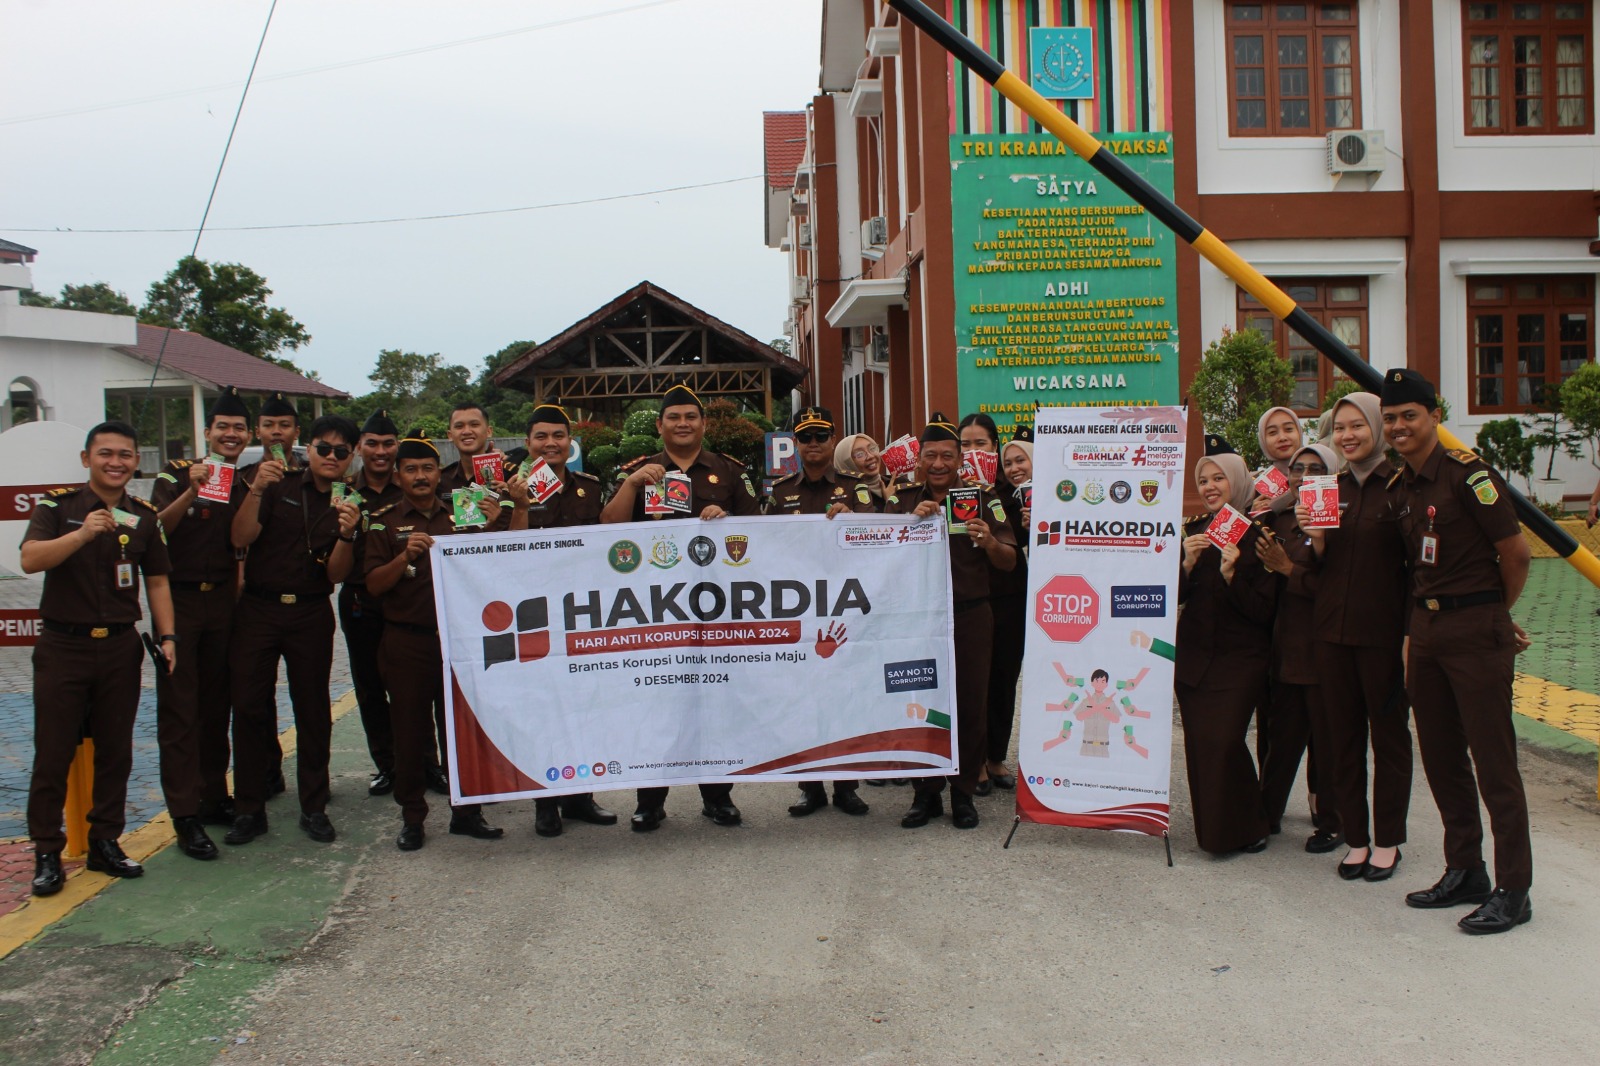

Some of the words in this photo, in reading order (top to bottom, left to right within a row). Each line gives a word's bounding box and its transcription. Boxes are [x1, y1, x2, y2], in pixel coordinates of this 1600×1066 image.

[962, 141, 993, 156] TRI
[1000, 140, 1067, 156] KRAMA
[1036, 180, 1098, 196] SATYA
[983, 207, 1048, 218] KESETIAAN
[1050, 206, 1078, 217] YANG
[1080, 205, 1145, 216] BERSUMBER
[1017, 217, 1046, 228] PADA
[1049, 216, 1078, 227] RASA
[1080, 215, 1115, 226] JUJUR
[998, 229, 1025, 239] BAIK
[1027, 228, 1087, 238] TERHADAP
[1090, 227, 1127, 237] TUHAN
[973, 241, 1006, 250] YANG
[1007, 239, 1040, 250] MAHA
[1070, 238, 1130, 248] TERHADAP
[1132, 236, 1155, 247] DIRI
[995, 250, 1043, 261] PRIBADI
[1045, 249, 1068, 260] DAN
[968, 263, 1015, 274] MAUPUN
[1017, 261, 1062, 272] KEPADA
[1065, 259, 1111, 270] SESAMA
[1113, 257, 1162, 269] MANUSIA
[1044, 281, 1089, 297] ADHI
[970, 301, 1063, 313] KESEMPURNAAN
[1065, 299, 1104, 310] DALAM
[1106, 297, 1165, 308] BERTUGAS
[1007, 313, 1030, 323] DAN
[1032, 310, 1091, 322] BERUNSUR
[1093, 308, 1134, 319] UTAMA
[1032, 322, 1062, 333] RASA
[1065, 321, 1127, 332] TANGGUNG
[971, 335, 999, 346] BAIK
[1001, 334, 1060, 345] TERHADAP
[1063, 333, 1101, 343] TUHAN
[1104, 332, 1135, 342] YANG
[1137, 330, 1168, 341] MAHA
[1023, 344, 1082, 355] TERHADAP
[1085, 343, 1145, 353] KELUARGA
[976, 357, 999, 367] DAN
[1001, 355, 1061, 366] TERHADAP
[1064, 354, 1109, 365] SESAMA
[1111, 353, 1162, 363] MANUSIA
[1013, 373, 1127, 390] WICAKSANA
[1037, 424, 1086, 435] KEJAKSAAN
[1087, 424, 1118, 435] NEGERI
[1120, 424, 1143, 434] ACEH
[1144, 424, 1178, 434] SINGKIL
[772, 437, 795, 470] P
[1147, 445, 1178, 453] bangga
[1072, 452, 1125, 461] BerAKHLAK
[1147, 460, 1177, 468] bangsa
[14, 493, 46, 513] ST
[1065, 520, 1176, 537] HAKORDIA
[845, 533, 892, 542] BerAKHLAK
[442, 545, 493, 557] KEJAKSAAN
[496, 542, 526, 553] NEGERI
[528, 540, 551, 551] ACEH
[554, 538, 585, 549] SINGKIL
[563, 578, 872, 631] HAKORDIA
[1043, 593, 1092, 613] STOP
[1114, 594, 1132, 602] SAY
[1042, 613, 1092, 625] CORRUPTION
[575, 636, 607, 649] HARI
[610, 634, 641, 646] ANTI
[645, 630, 699, 644] KORUPSI
[701, 629, 757, 641] SEDUNIA
[758, 627, 790, 639] 2024
[568, 661, 618, 673] Brantas
[622, 654, 672, 672] Korupsi
[675, 653, 707, 666] Untuk
[710, 651, 772, 665] Indonesia
[775, 650, 807, 665] Maju
[887, 669, 905, 679] SAY
[907, 668, 920, 677] NO
[923, 666, 935, 675] TO
[634, 676, 640, 687] 9
[644, 673, 700, 686] DESEMBER
[702, 673, 730, 684] 2024
[890, 676, 934, 686] CORRUPTION
